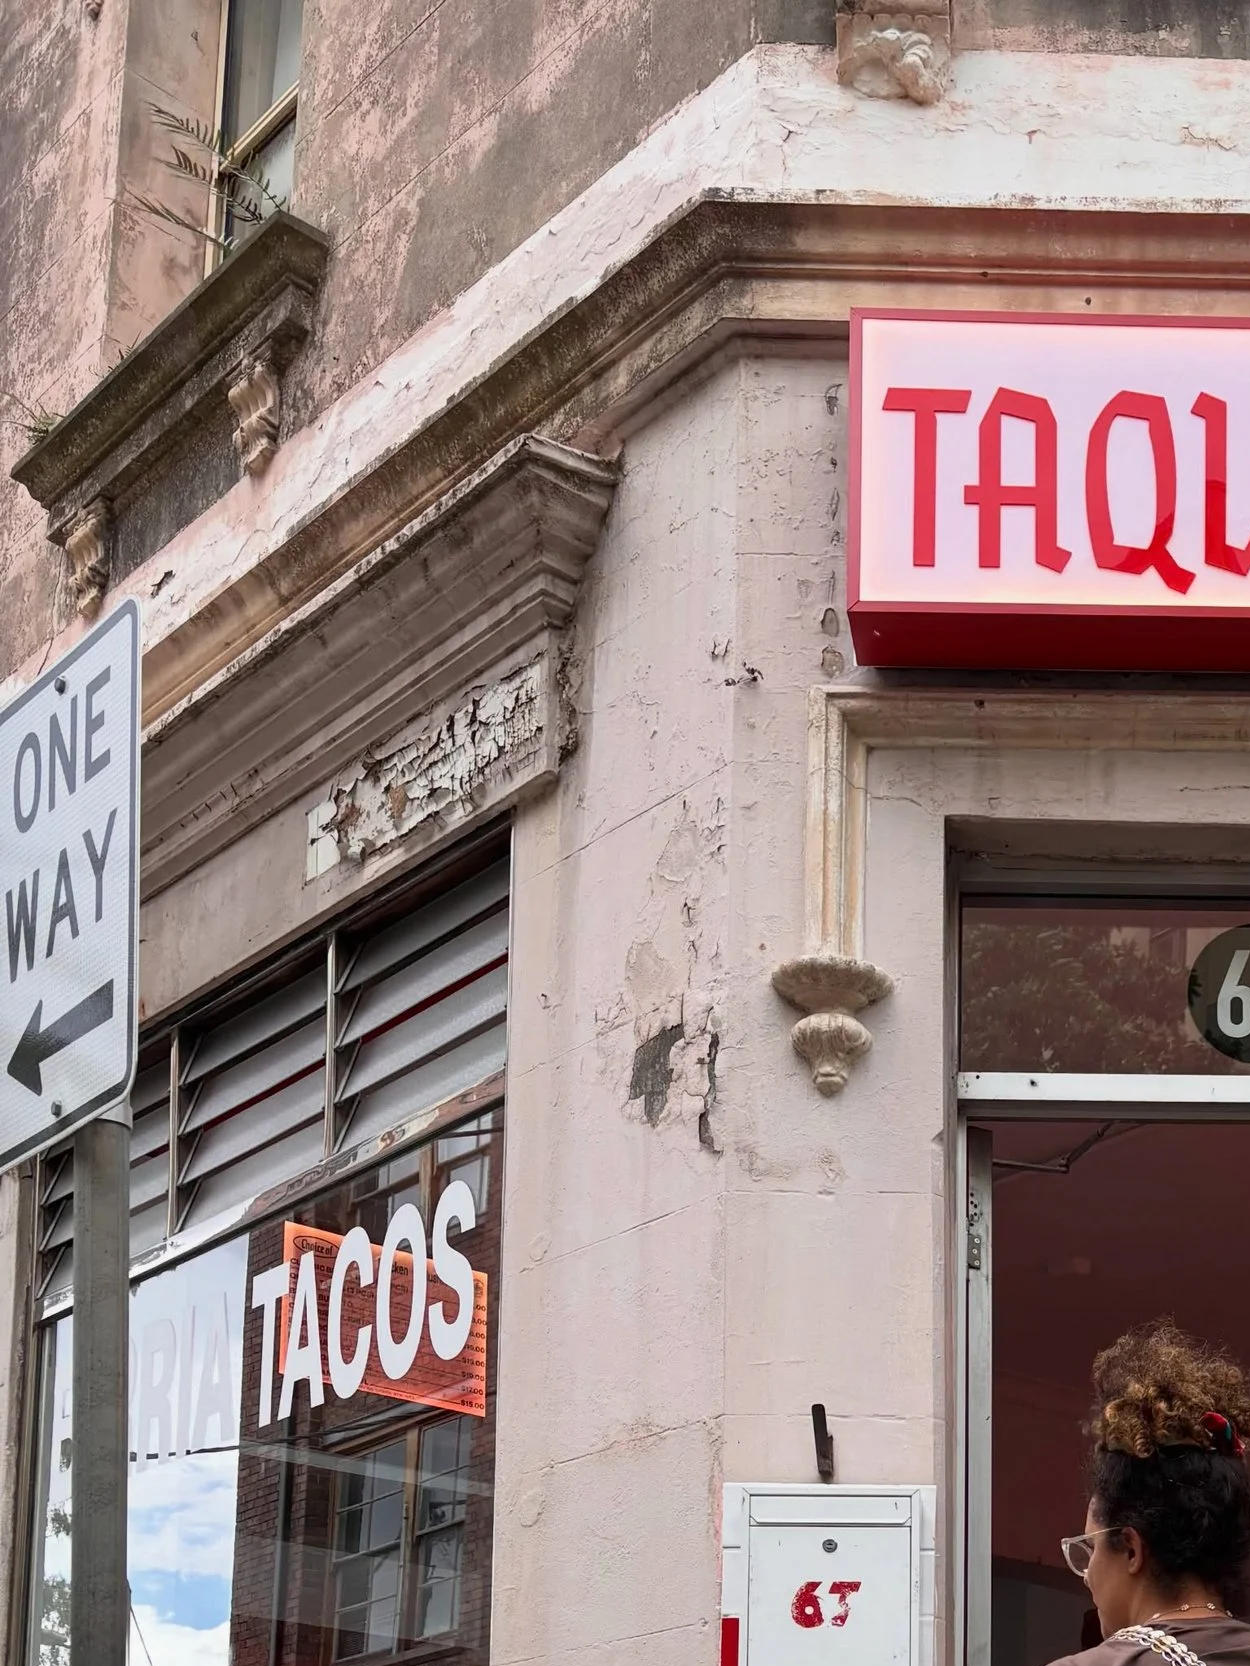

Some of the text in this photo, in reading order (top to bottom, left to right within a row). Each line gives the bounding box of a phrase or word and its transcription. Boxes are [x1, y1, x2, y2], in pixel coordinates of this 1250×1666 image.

[13, 665, 112, 834] ONE
[5, 807, 118, 984] WAY
[251, 1180, 477, 1429] TACOS
[325, 1247, 334, 1255] of
[791, 1580, 862, 1628] 67
